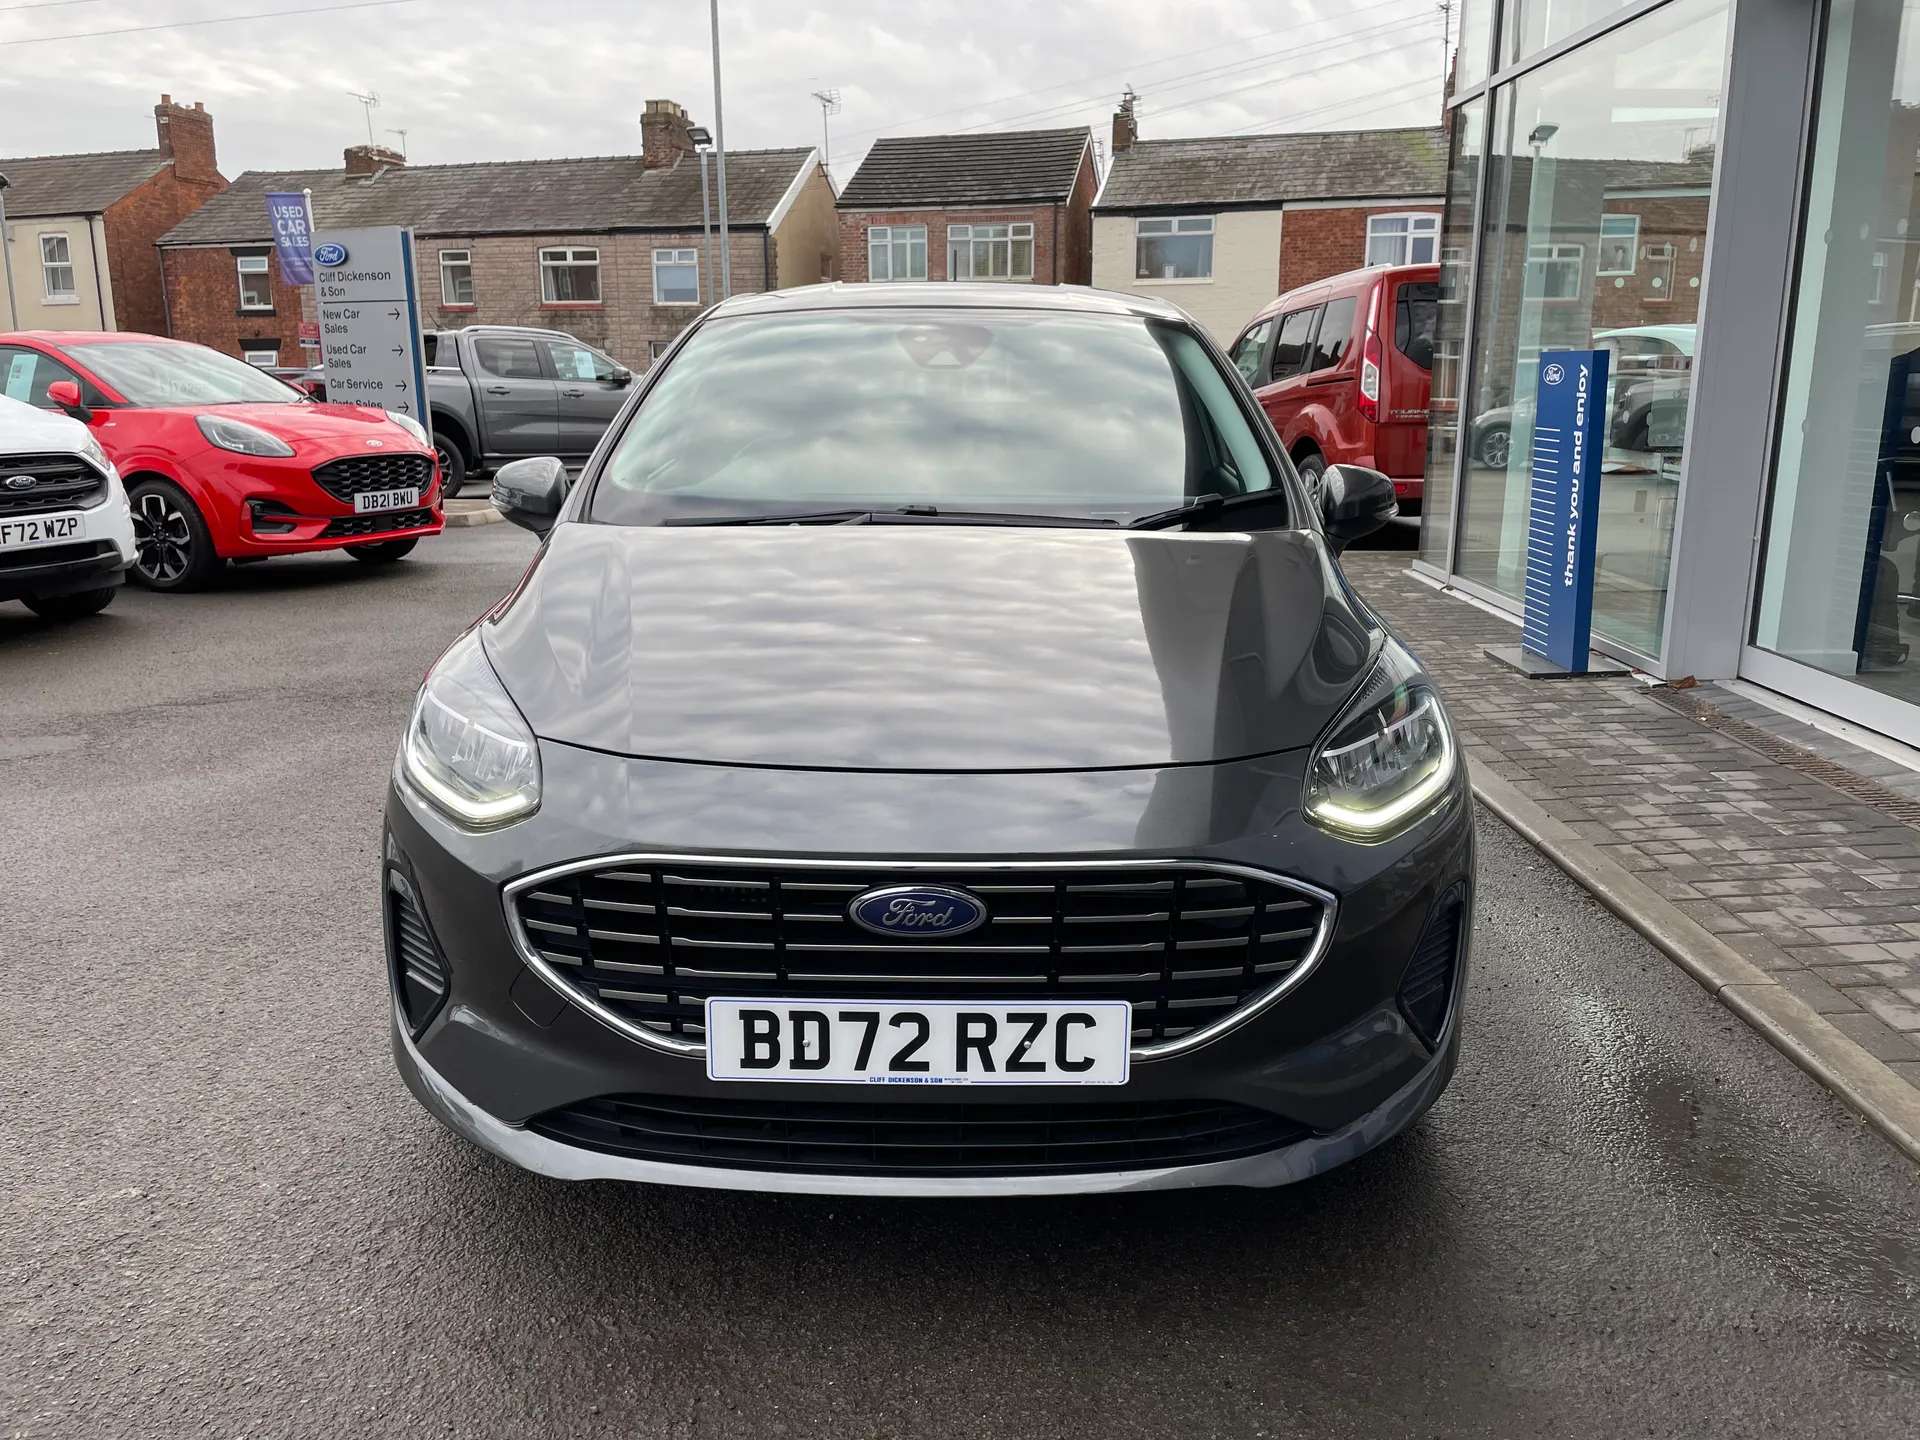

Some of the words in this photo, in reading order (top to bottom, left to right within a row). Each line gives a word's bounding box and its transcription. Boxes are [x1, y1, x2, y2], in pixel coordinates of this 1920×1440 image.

[273, 206, 304, 219] USED
[277, 219, 306, 236] CAR
[280, 236, 310, 248] SALES
[319, 247, 339, 263] Ford
[319, 272, 336, 283] Cliff
[338, 270, 391, 283] Dickenson
[320, 287, 327, 297] &
[328, 285, 346, 297] Son
[323, 309, 342, 320] New
[343, 308, 361, 320] Car
[324, 323, 349, 334] Sales
[326, 344, 349, 355] Used
[350, 344, 367, 355] Car
[328, 358, 352, 369] Sales
[1547, 367, 1561, 381] Ford
[330, 378, 345, 389] Car
[346, 378, 384, 390] Service
[1576, 363, 1589, 426] enjoy
[1573, 431, 1583, 475] and
[362, 493, 391, 510] DB21
[393, 490, 413, 507] BWU
[1570, 479, 1580, 519] you
[0, 522, 40, 545] F72
[43, 517, 78, 538] WZP
[1564, 523, 1577, 587] thank
[882, 898, 955, 927] Ford
[738, 1009, 930, 1072] BD72
[955, 1012, 1097, 1073] RZC
